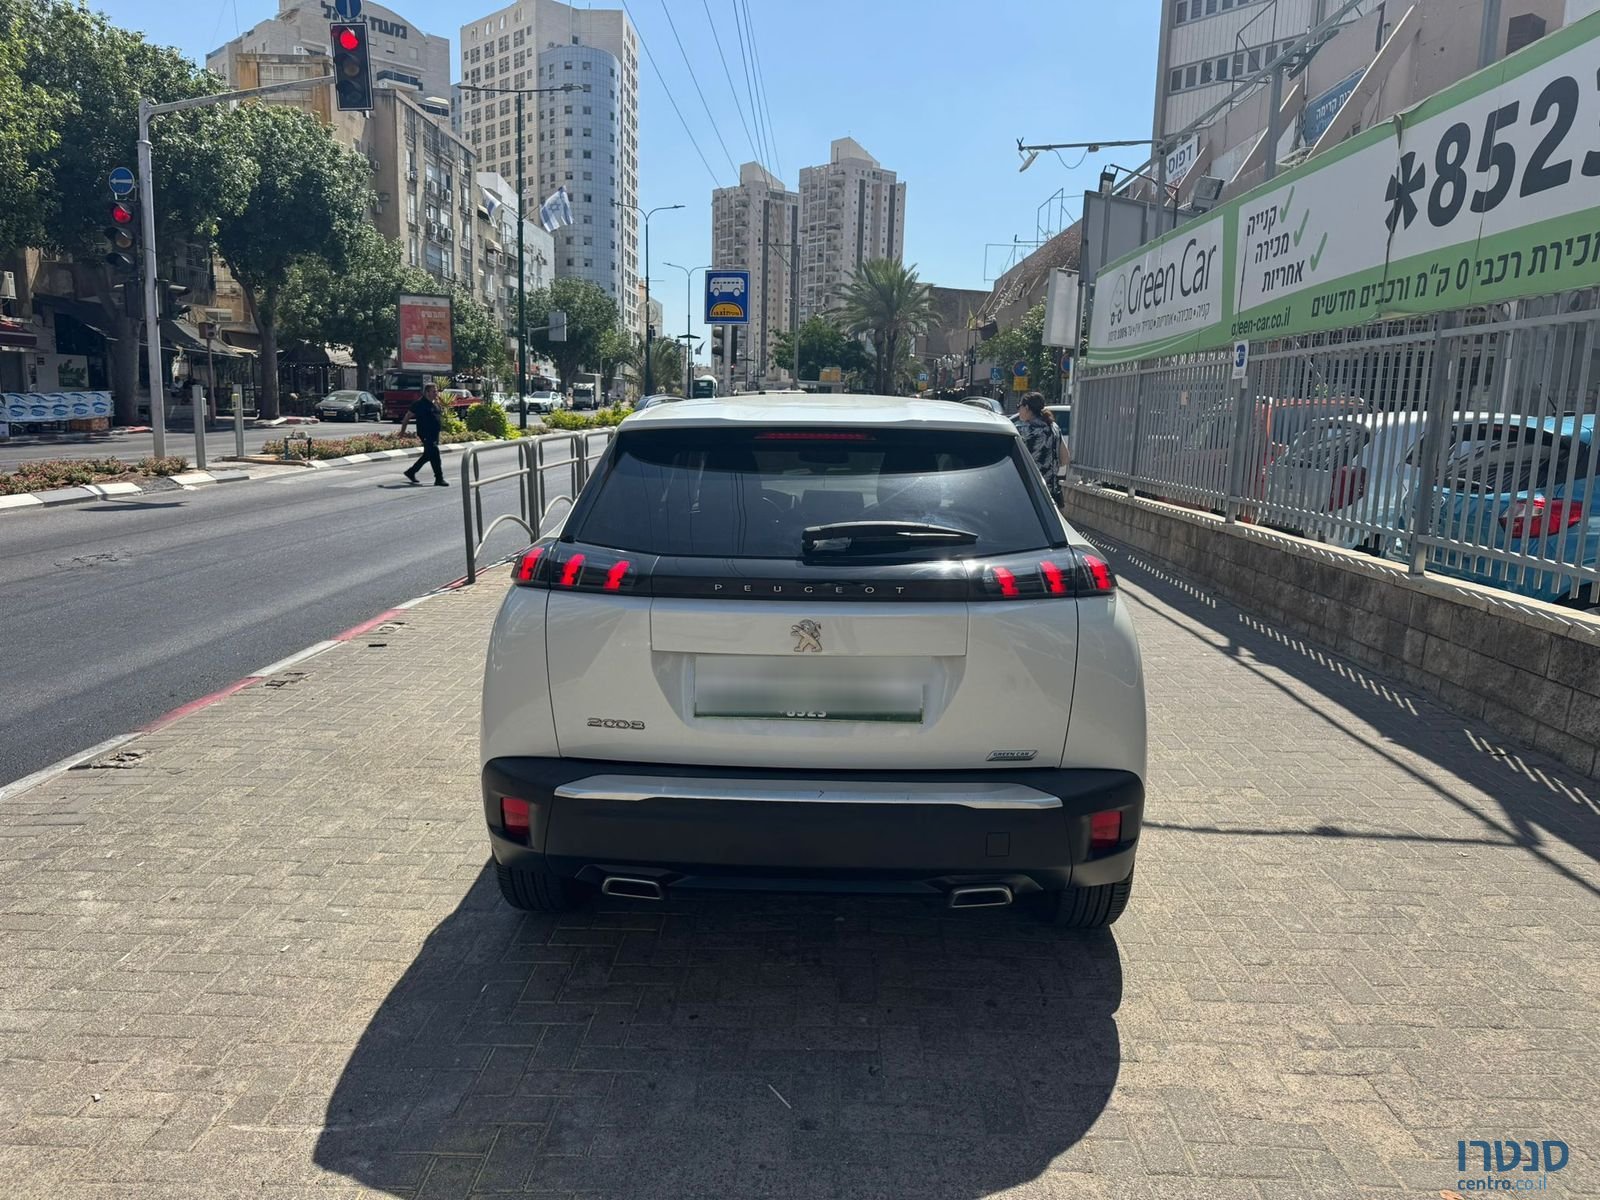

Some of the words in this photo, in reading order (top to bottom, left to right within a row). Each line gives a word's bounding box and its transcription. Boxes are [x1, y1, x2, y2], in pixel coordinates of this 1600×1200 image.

[1316, 97, 1337, 121] קדימה
[1168, 144, 1193, 174] דפוס
[1247, 205, 1278, 236] קנייה
[1255, 232, 1290, 264] מכירה
[1127, 263, 1175, 315] Green
[1180, 238, 1217, 298] Car
[1262, 259, 1305, 292] אחריות
[1455, 258, 1470, 290] 0
[1476, 251, 1522, 286] רכבי
[1311, 288, 1356, 318] חדשים
[1359, 275, 1410, 309] ורכבים
[714, 583, 905, 594] PEUGEOT
[587, 717, 646, 731] 2008
